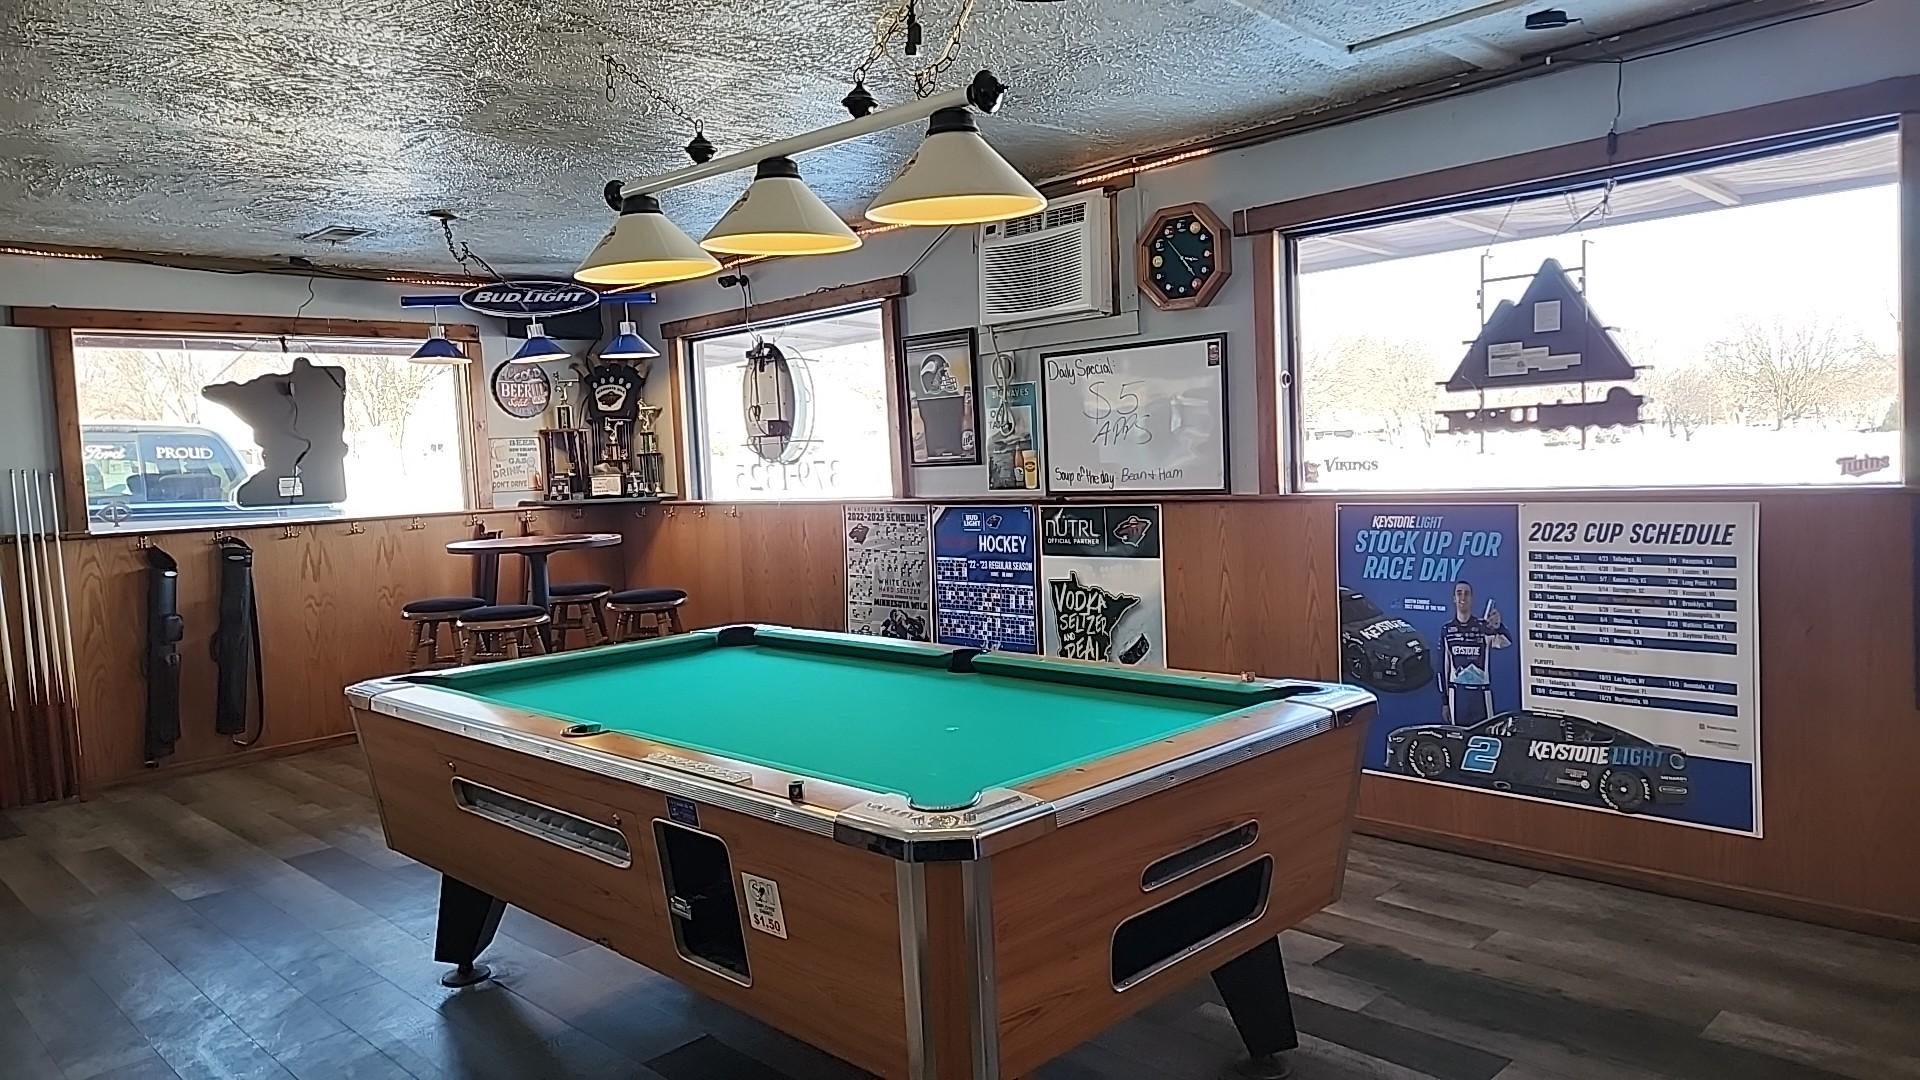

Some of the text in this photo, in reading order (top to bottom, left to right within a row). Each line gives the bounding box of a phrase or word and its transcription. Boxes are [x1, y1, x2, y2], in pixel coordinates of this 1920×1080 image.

[473, 291, 585, 303] BUD LIGHT
[1048, 360, 1076, 385] Daily
[501, 383, 532, 397] BEER
[1092, 414, 1153, 446] APPS
[84, 445, 126, 459] Ford
[156, 446, 214, 459] PROUD
[1836, 453, 1890, 477] Twins
[1055, 467, 1074, 486] Soup
[1077, 466, 1085, 483] of
[1086, 468, 1100, 485] the
[1121, 468, 1146, 482] Bean
[1159, 468, 1183, 480] Ham
[848, 512, 926, 522] 2022-2023 SCHEDULE
[1372, 516, 1444, 529] KEYSTONE LIGHT
[1355, 530, 1502, 556] STOCK UP FOR
[1528, 522, 1736, 546] 2023 CUP SCHEDULE
[979, 535, 1027, 553] HOCKEY
[988, 561, 1012, 570] REGULAR
[1012, 562, 1033, 571] SEASON
[1363, 556, 1465, 582] RACE DAY
[874, 598, 928, 610] MINNESOTA WILD
[1054, 582, 1107, 613] VODKA
[1060, 612, 1109, 636] SELTZER
[1063, 633, 1076, 642] AND
[1452, 646, 1480, 656] KEYSTONE
[1461, 736, 1502, 774] 2
[1528, 740, 1664, 768] KEYSTONE LIGHT
[754, 913, 781, 932] $1.50
